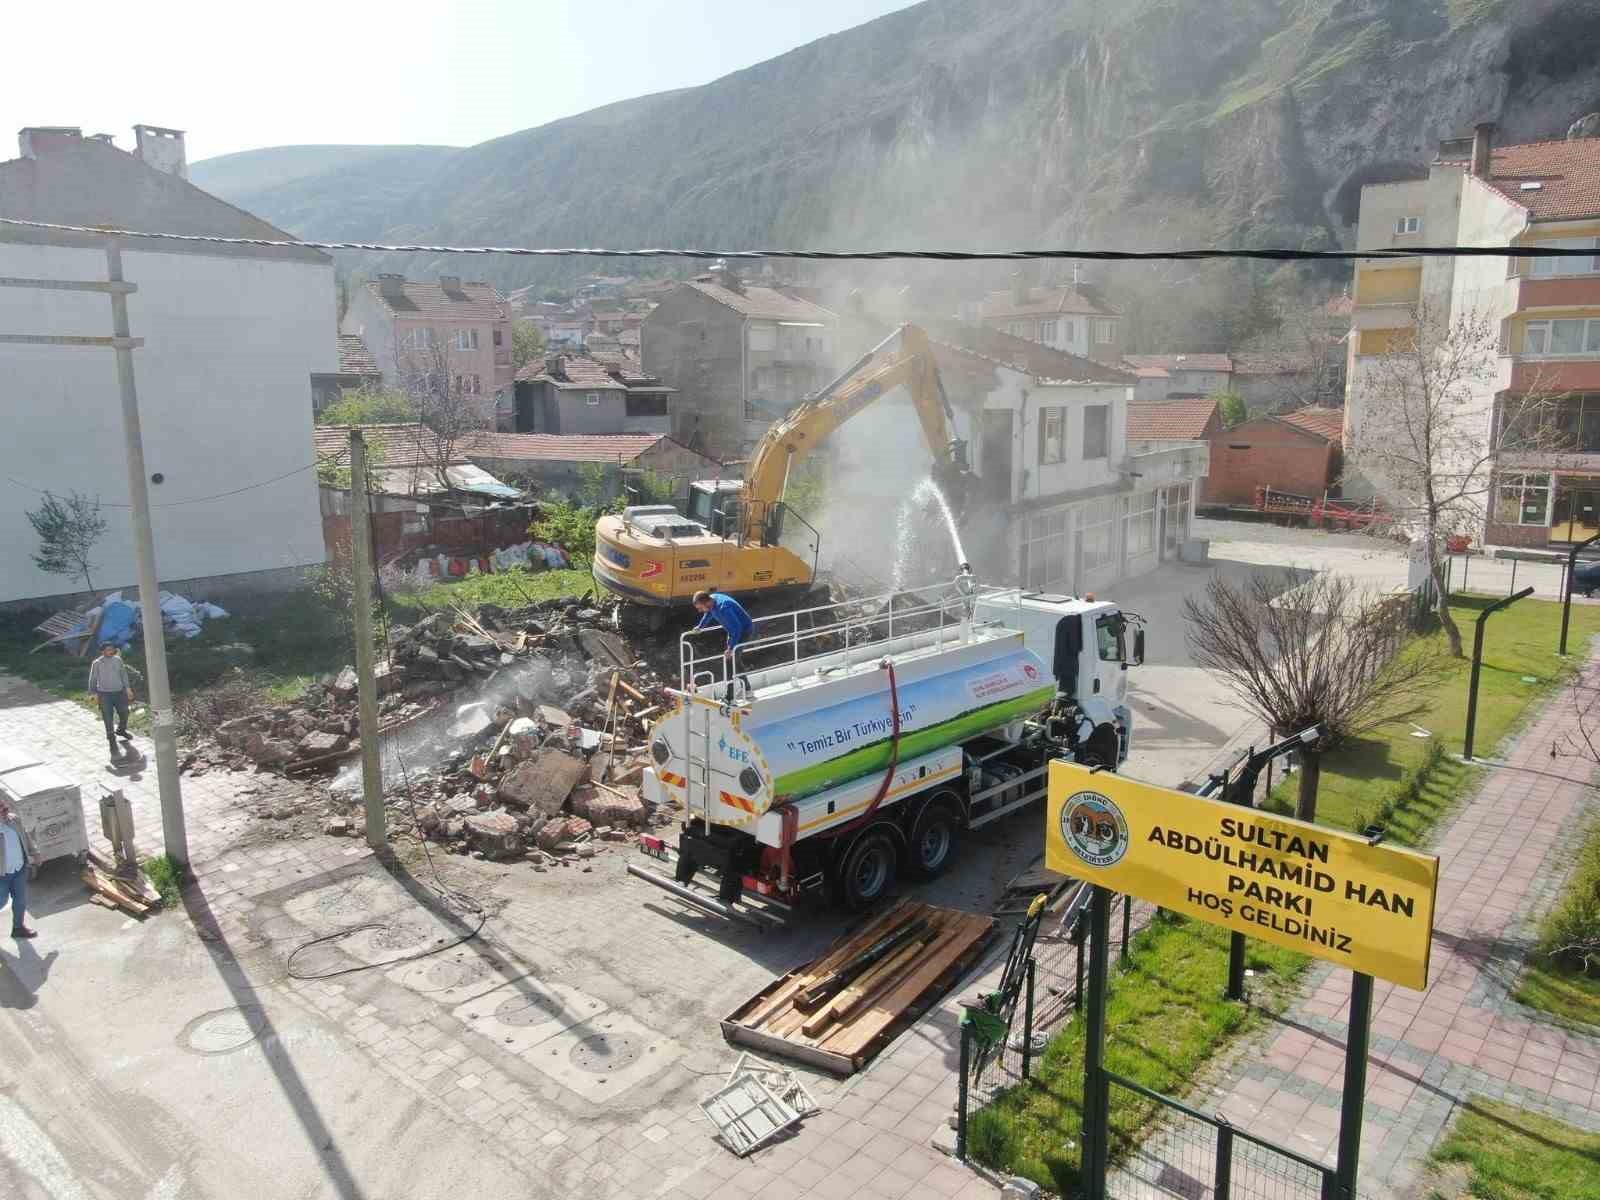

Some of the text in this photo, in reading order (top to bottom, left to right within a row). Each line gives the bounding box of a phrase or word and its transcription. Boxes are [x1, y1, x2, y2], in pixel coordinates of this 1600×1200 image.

[729, 746, 749, 763] EFE
[834, 728, 852, 743] Bir
[1220, 817, 1329, 864] SULTAN
[1148, 825, 1414, 918] ABDÜLHAMİD HAN
[1227, 875, 1313, 917] PARKI
[1187, 887, 1353, 954] HOŞ GELDİNİZ
